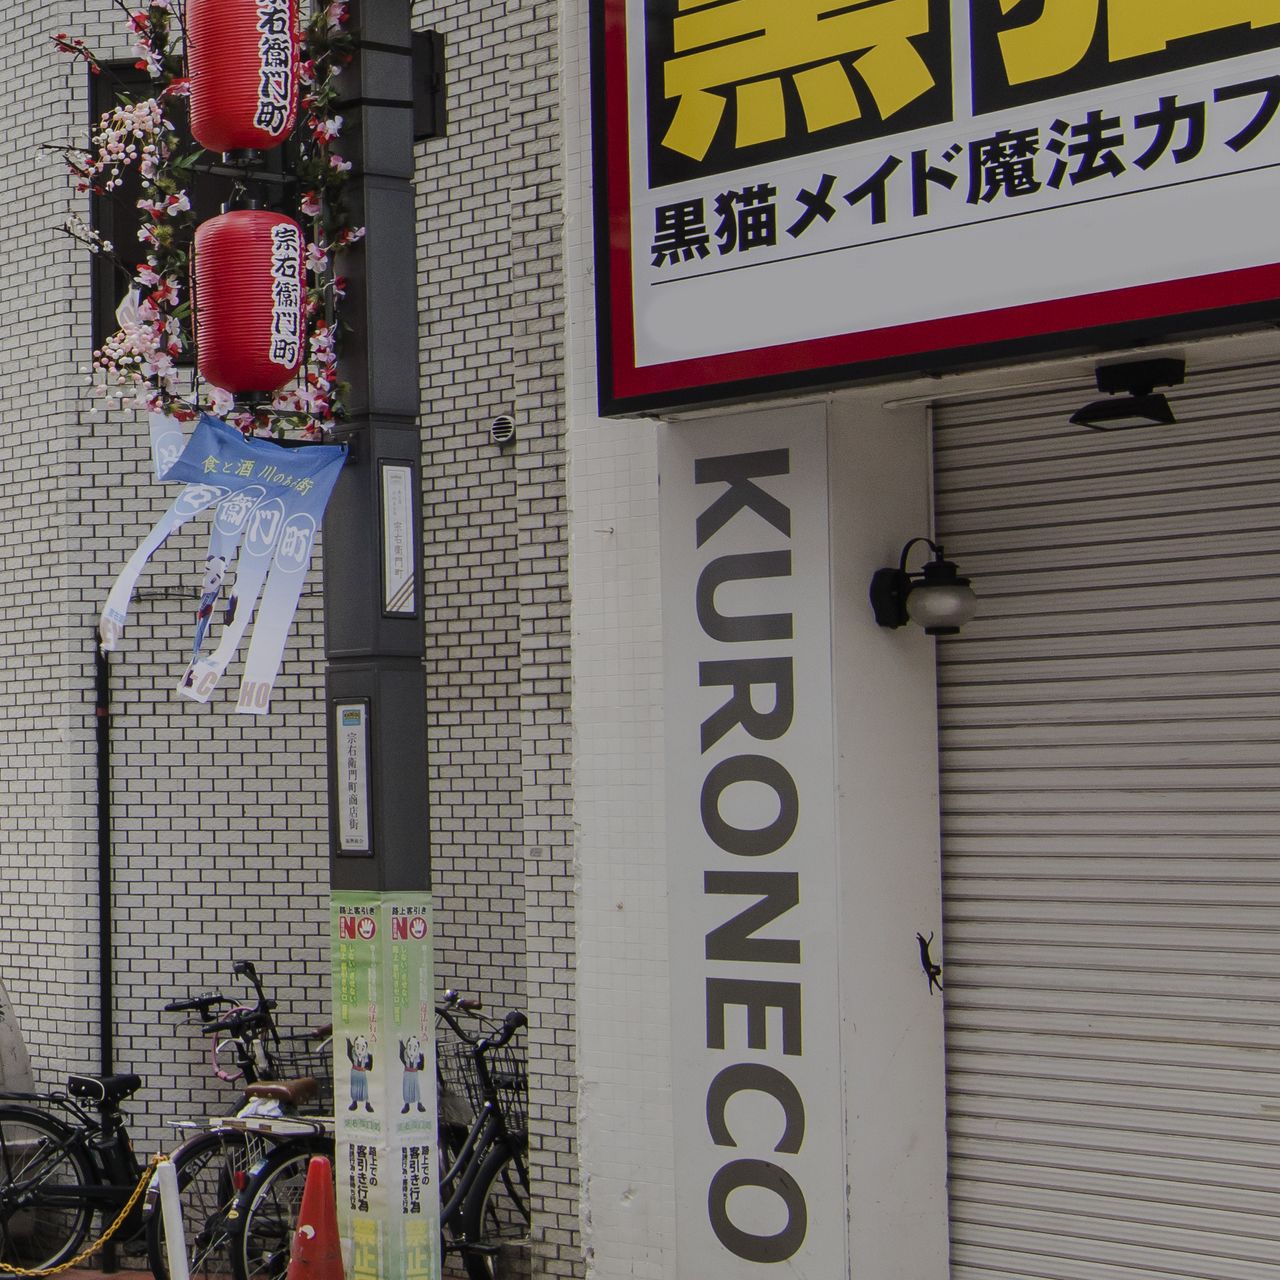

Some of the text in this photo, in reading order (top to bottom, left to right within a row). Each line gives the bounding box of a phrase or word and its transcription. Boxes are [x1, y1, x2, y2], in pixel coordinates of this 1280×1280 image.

[274, 227, 298, 363] 宗右衛門町
[201, 454, 254, 477] 食と酒
[347, 732, 359, 831] 宗右衛門町商店街
[694, 447, 809, 1264] KURONECO
[339, 906, 375, 915] 路上客引き
[392, 906, 427, 916] 路上客引き
[356, 1144, 369, 1213] 客引き行為
[368, 1146, 378, 1187] 路上での
[409, 1146, 421, 1214] 客引き行為
[421, 1145, 430, 1185] 路上での
